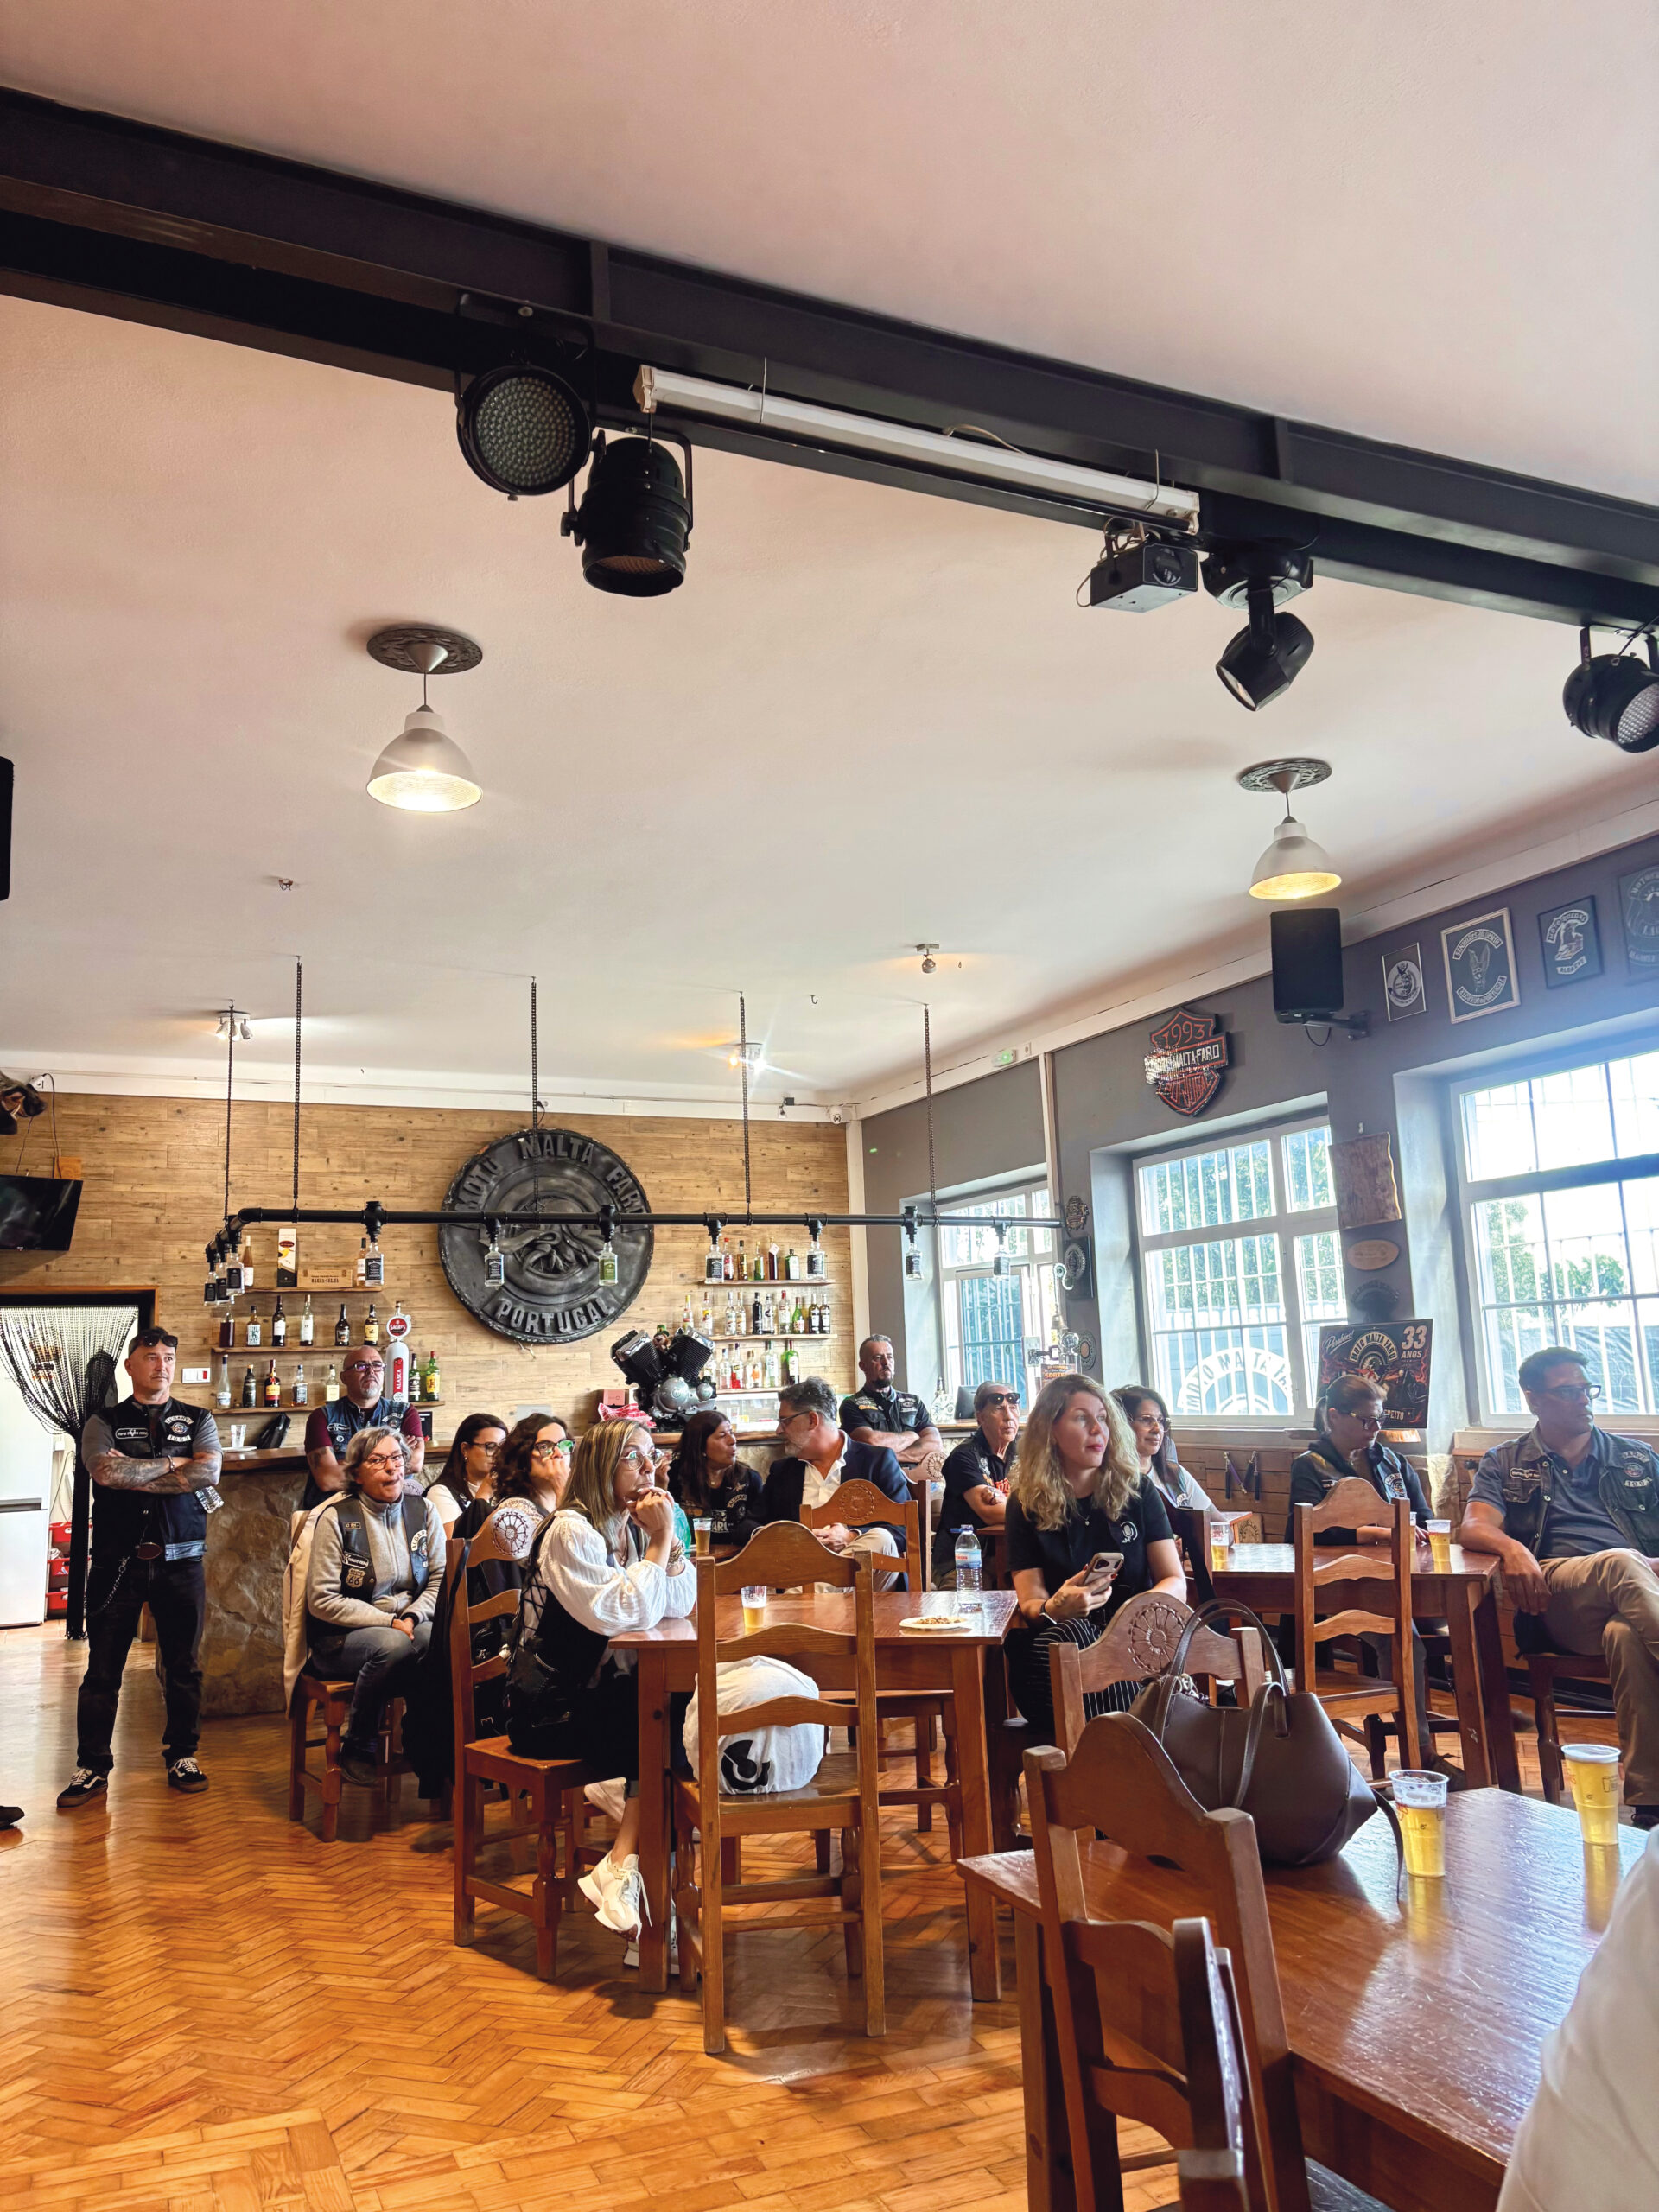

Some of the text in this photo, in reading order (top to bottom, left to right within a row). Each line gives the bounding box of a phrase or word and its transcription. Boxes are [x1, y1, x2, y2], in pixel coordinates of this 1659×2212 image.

[1161, 1020, 1205, 1049] 1993
[518, 1135, 594, 1164] MALTA
[497, 1297, 615, 1334] PORTUGAL
[1351, 1333, 1397, 1361] MOTO MALTA FARO
[1401, 1325, 1427, 1351] 33
[1401, 1350, 1422, 1359] ANOS
[1186, 1363, 1214, 1409] MOO
[347, 1575, 360, 1586] 66
